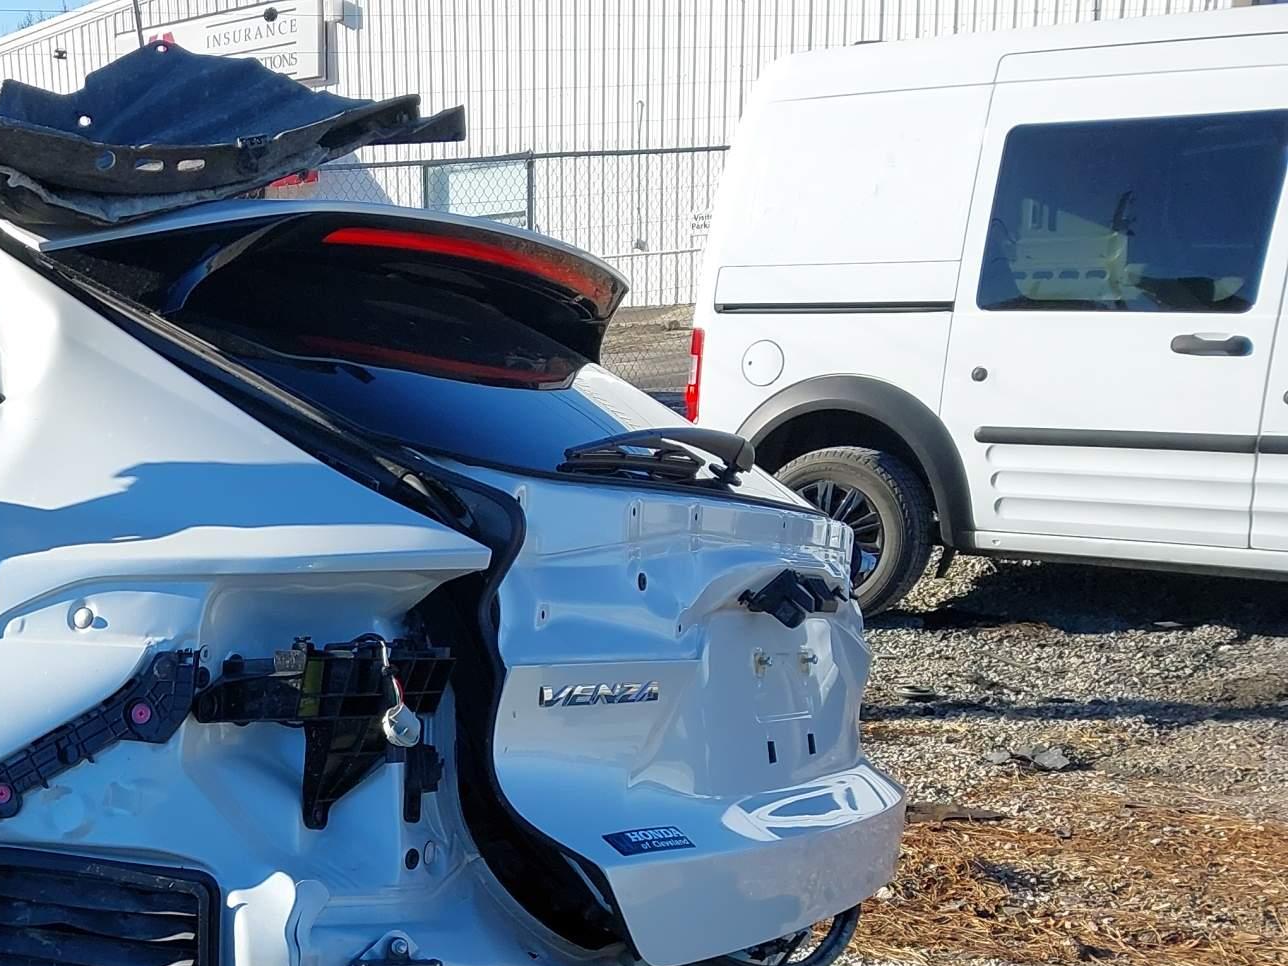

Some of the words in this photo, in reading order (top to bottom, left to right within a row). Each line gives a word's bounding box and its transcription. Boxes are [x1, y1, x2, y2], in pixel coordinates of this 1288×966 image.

[206, 18, 298, 49] INSURANCE
[259, 52, 298, 70] TIONS
[539, 680, 659, 707] VENZA
[625, 828, 684, 842] HONDA
[640, 841, 652, 850] of
[652, 838, 691, 849] Cleveland
